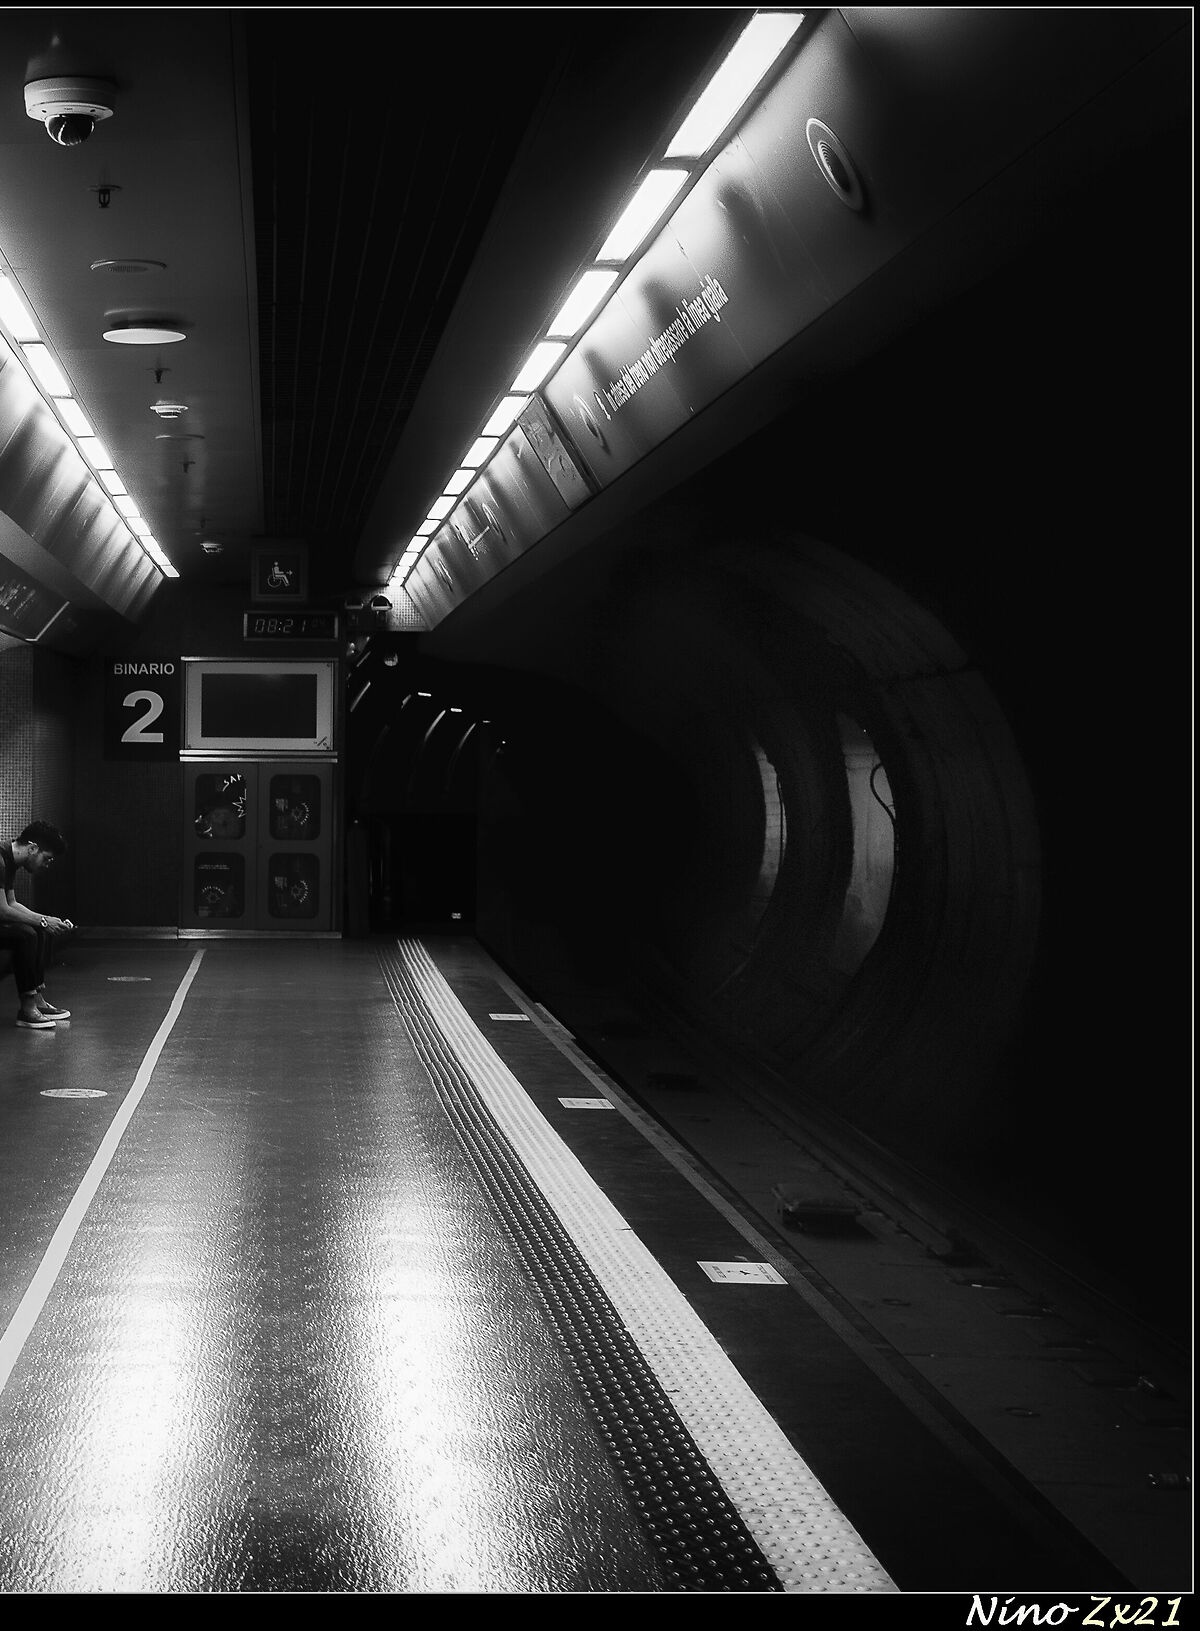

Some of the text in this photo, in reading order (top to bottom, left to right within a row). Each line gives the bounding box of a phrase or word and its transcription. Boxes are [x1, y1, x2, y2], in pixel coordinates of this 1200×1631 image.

[700, 273, 729, 323] gialla
[675, 307, 697, 336] la
[681, 298, 712, 330] linea
[648, 317, 690, 364] oltrepassare
[625, 359, 650, 389] treno
[640, 349, 660, 377] non
[618, 364, 639, 395] del
[255, 619, 306, 634] 08:21
[113, 663, 175, 676] BINARIO
[121, 690, 164, 743] 2
